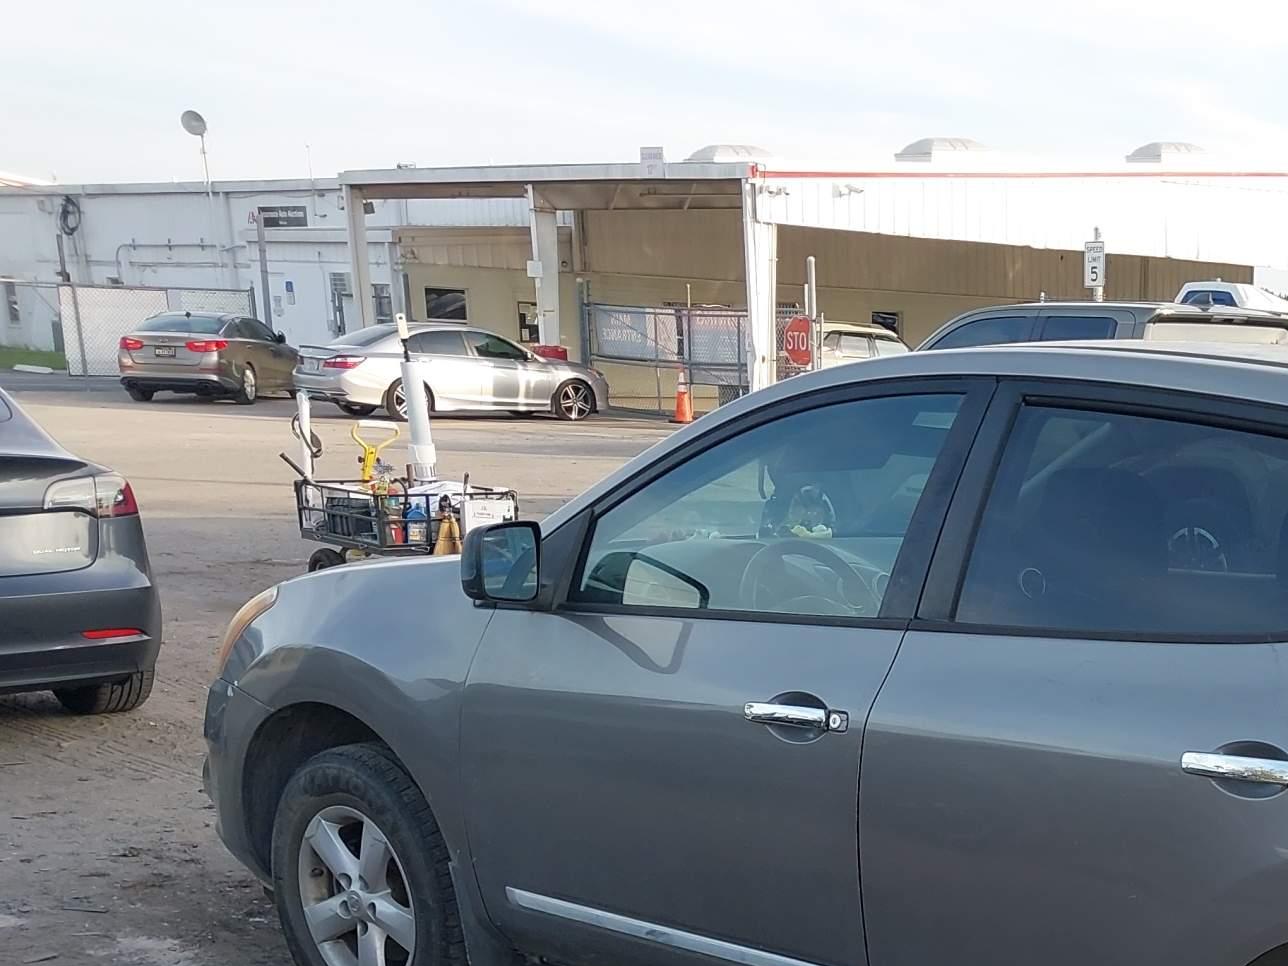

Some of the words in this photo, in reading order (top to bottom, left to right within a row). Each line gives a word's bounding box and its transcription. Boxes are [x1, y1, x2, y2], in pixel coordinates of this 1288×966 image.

[1087, 255, 1101, 263] LIMIT
[1090, 266, 1098, 282] 5
[786, 331, 807, 351] STO
